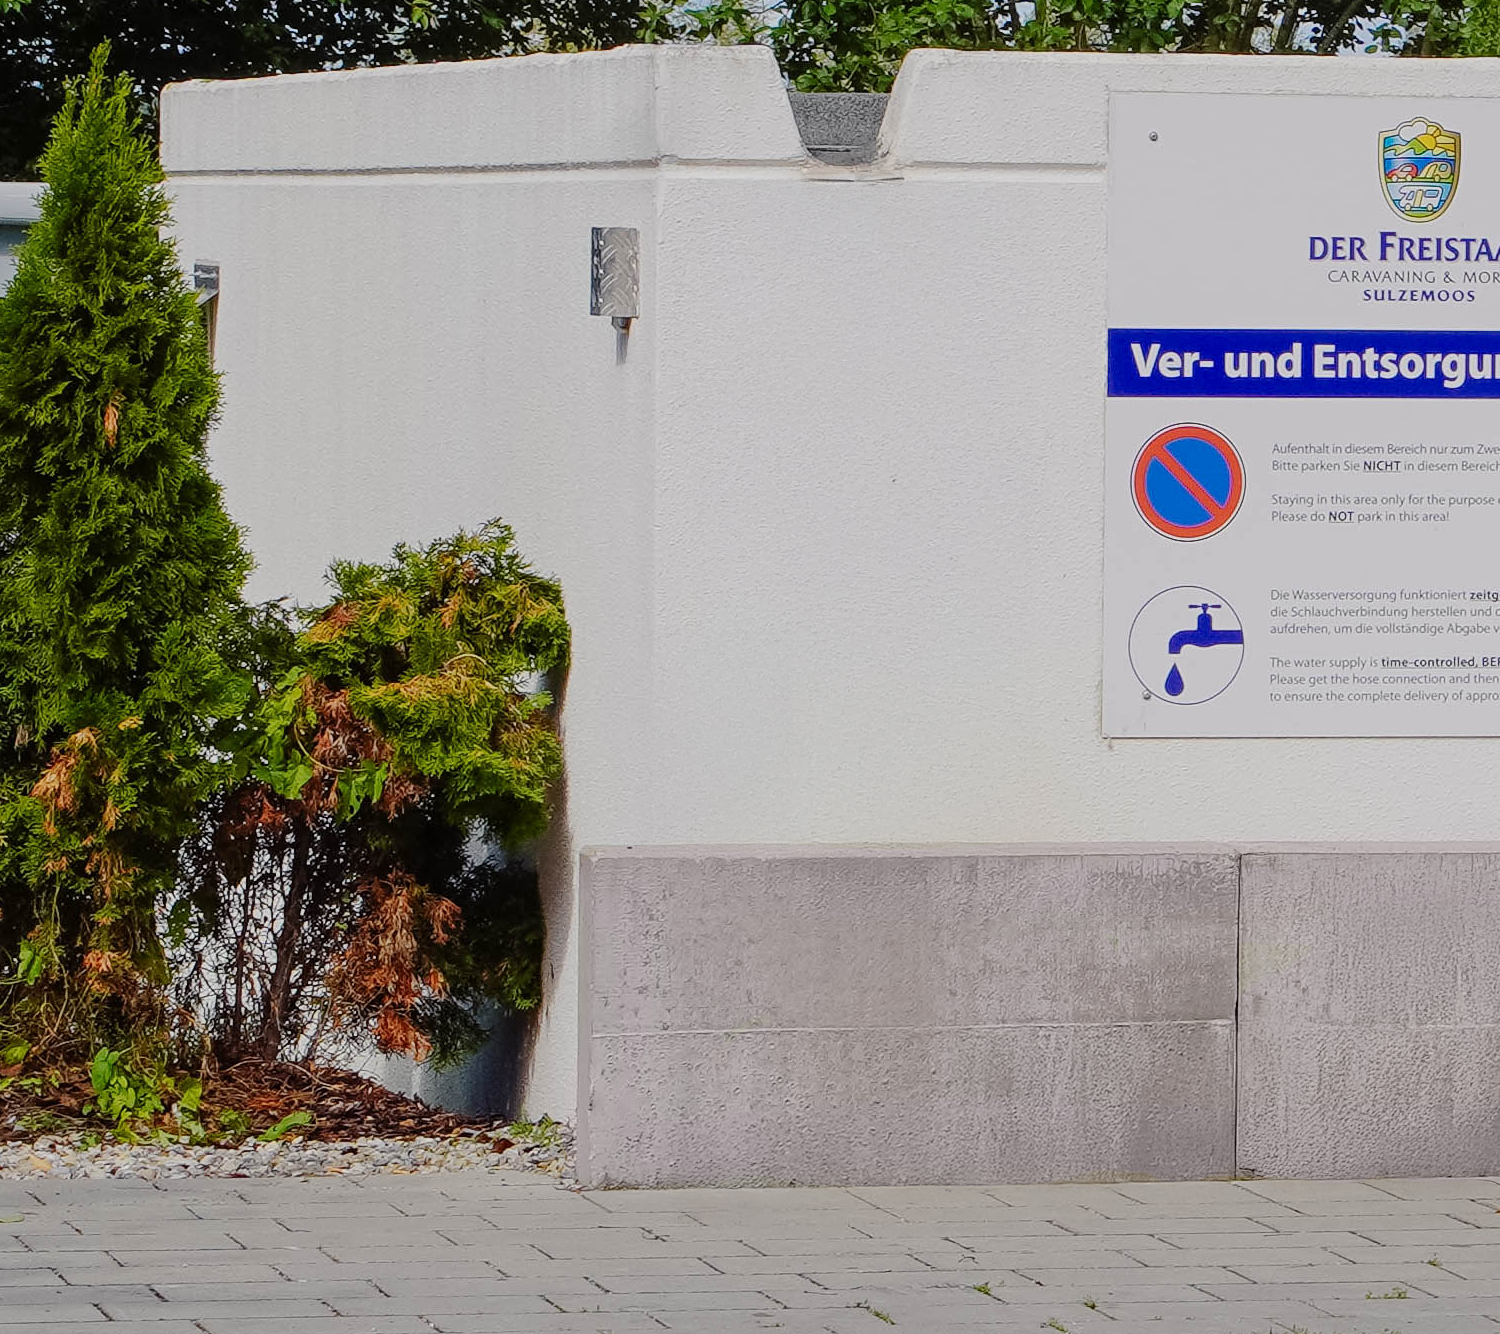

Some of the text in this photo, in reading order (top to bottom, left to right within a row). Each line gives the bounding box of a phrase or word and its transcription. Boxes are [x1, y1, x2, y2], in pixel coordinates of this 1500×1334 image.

[1309, 236, 1366, 261] DER
[1328, 270, 1436, 284] CARAVANING
[1443, 271, 1456, 284] &
[1363, 289, 1476, 302] SULZEMOOS
[1130, 343, 1214, 378] Ver-
[1225, 343, 1302, 379] und
[1272, 443, 1330, 455] Aufenthalt
[1332, 443, 1342, 455] in
[1344, 443, 1384, 455] diesem
[1387, 443, 1427, 455] Bereich
[1430, 446, 1448, 455] nur
[1450, 446, 1474, 455] zum
[1272, 460, 1298, 471] Bitte
[1301, 460, 1340, 474] parken
[1343, 460, 1361, 471] Sie
[1363, 460, 1401, 471] NICHT
[1404, 460, 1414, 471] in
[1417, 460, 1458, 471] diesem
[1272, 494, 1314, 508] Staying
[1317, 494, 1328, 505] in
[1330, 494, 1351, 505] this
[1354, 496, 1378, 505] area
[1381, 494, 1405, 508] only
[1408, 494, 1424, 505] for
[1427, 494, 1446, 505] the
[1448, 497, 1495, 508] purpose
[1272, 510, 1450, 525] Please do NOT park in this area!
[1270, 589, 1290, 601] Die
[1292, 589, 1396, 603] Wasserversorgung
[1399, 589, 1467, 601] funktioniert
[1270, 606, 1288, 617] die
[1291, 606, 1408, 620] Schlauchverbindung
[1411, 606, 1467, 617] herstellen
[1470, 605, 1492, 617] und
[1269, 622, 1331, 636] aufdrehen,
[1334, 625, 1352, 634] um
[1355, 622, 1373, 634] die
[1375, 622, 1444, 637] vollständige
[1447, 622, 1491, 637] Abgabe
[1270, 656, 1291, 668] The
[1293, 657, 1326, 668] water
[1329, 656, 1367, 671] supply
[1369, 656, 1379, 668] is
[1381, 656, 1478, 669] time-controlled,
[1270, 673, 1306, 685] Please
[1308, 674, 1328, 687] get
[1331, 673, 1349, 684] the
[1352, 673, 1379, 684] hose
[1382, 673, 1446, 684] connection
[1449, 672, 1470, 684] and
[1473, 672, 1500, 684] then
[1270, 691, 1281, 701] to
[1284, 692, 1323, 701] ensure
[1326, 689, 1345, 701] the
[1347, 689, 1401, 704] complete
[1404, 689, 1449, 704] delivery
[1451, 689, 1463, 701] of
